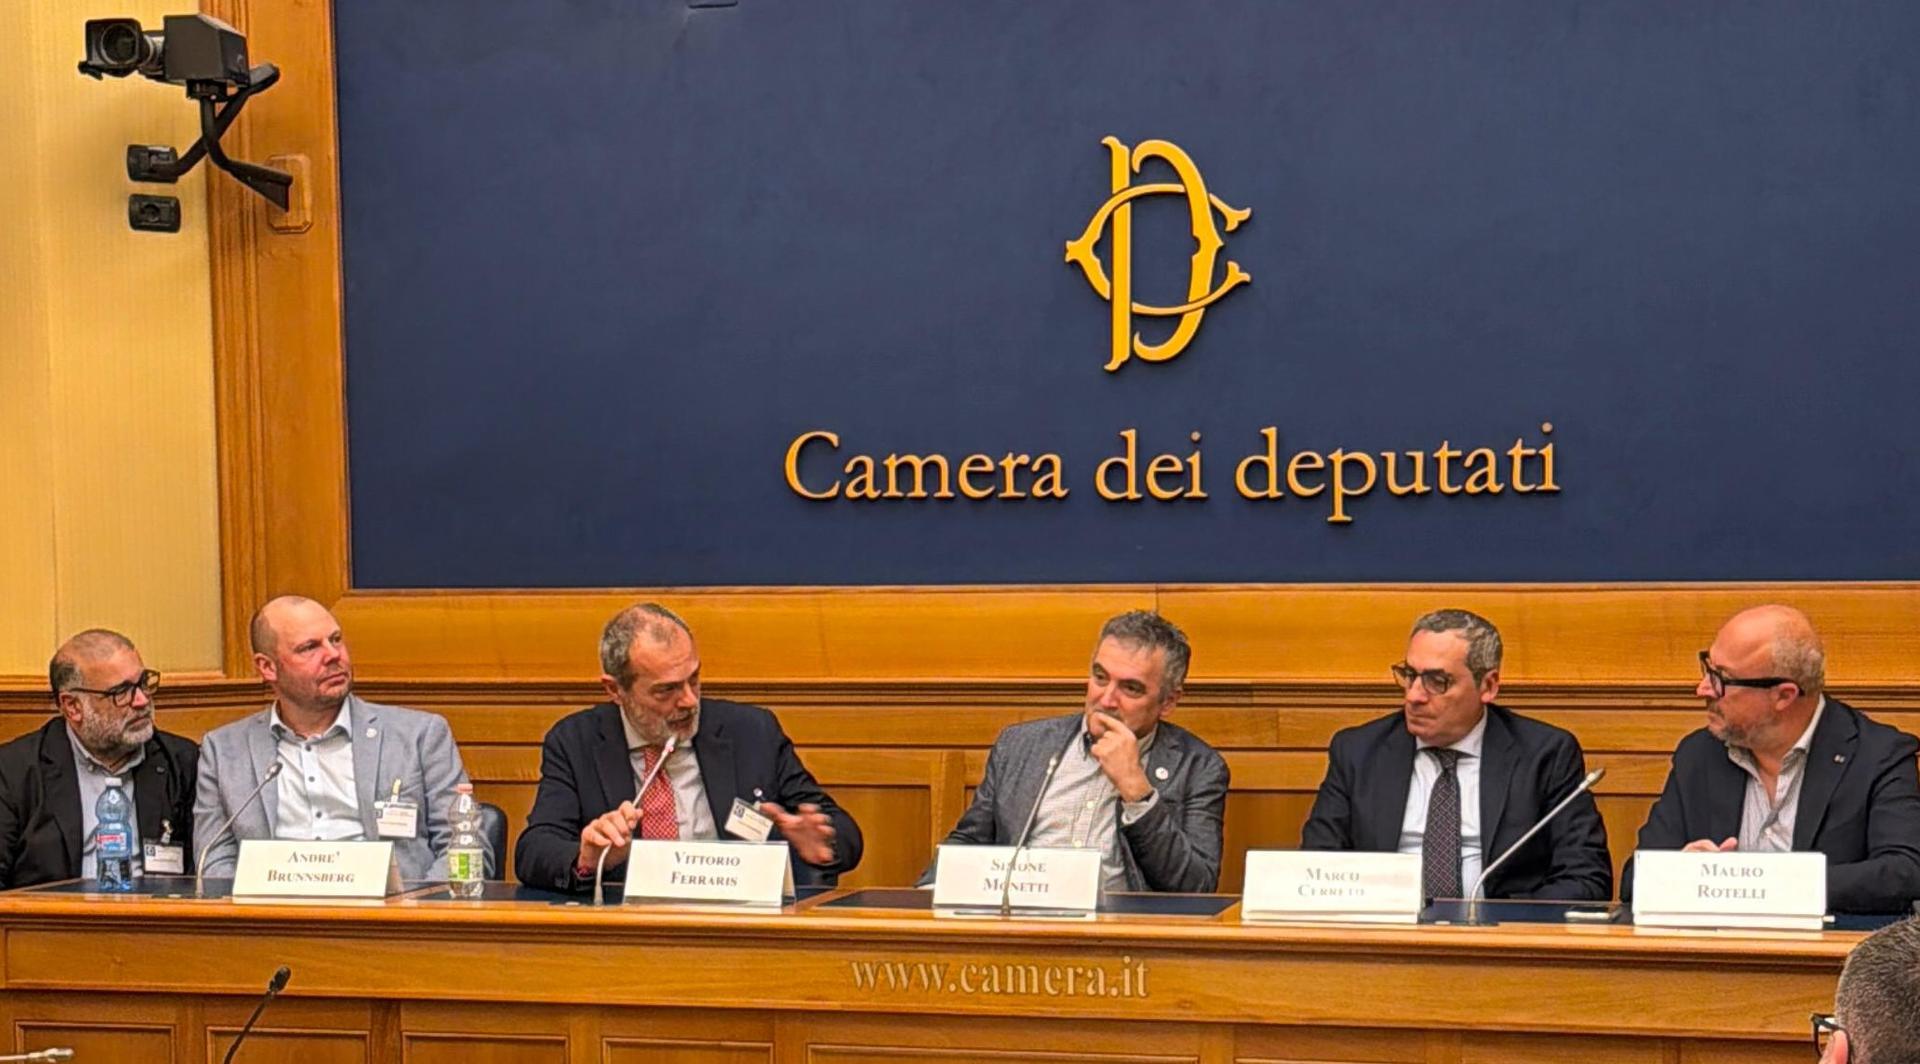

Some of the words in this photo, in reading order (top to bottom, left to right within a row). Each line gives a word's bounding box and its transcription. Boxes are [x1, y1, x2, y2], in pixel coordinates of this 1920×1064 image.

[783, 430, 1070, 500] Camera
[1094, 428, 1209, 501] dei
[1234, 421, 1561, 523] deputati
[674, 851, 741, 867] VITTORIO
[266, 869, 356, 884] BRUNNSBERG
[1305, 867, 1361, 882] MARCO
[1700, 863, 1765, 878] MAURO
[670, 871, 738, 887] FERRARIS
[1697, 884, 1767, 900] ROTELLI
[851, 955, 1149, 998] www.camera.it
